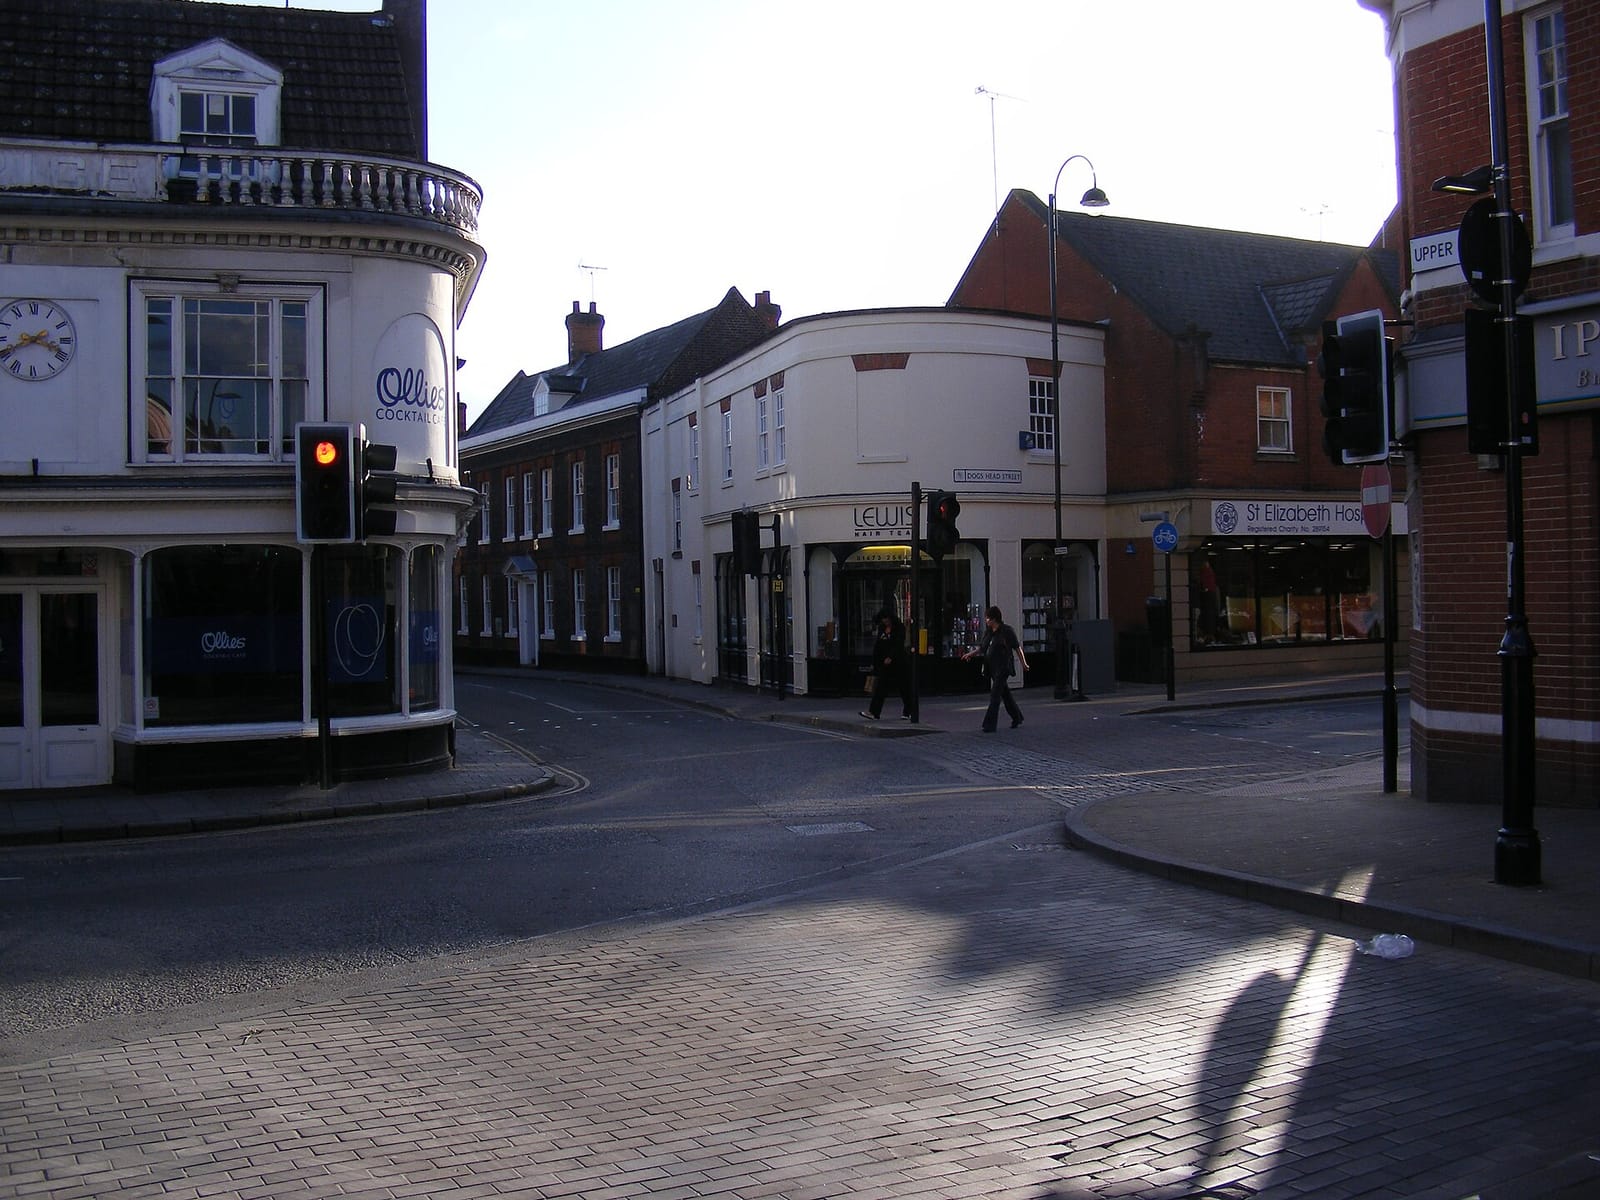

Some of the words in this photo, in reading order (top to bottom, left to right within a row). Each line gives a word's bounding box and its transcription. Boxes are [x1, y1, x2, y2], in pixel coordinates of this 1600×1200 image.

[1414, 241, 1453, 262] UPPER
[376, 408, 431, 423] COCKTAIL
[967, 472, 984, 480] DOGS
[985, 472, 1001, 480] HEAD
[1002, 473, 1020, 481] STREET
[1247, 504, 1259, 521] St
[1265, 504, 1331, 522] Elizabeth
